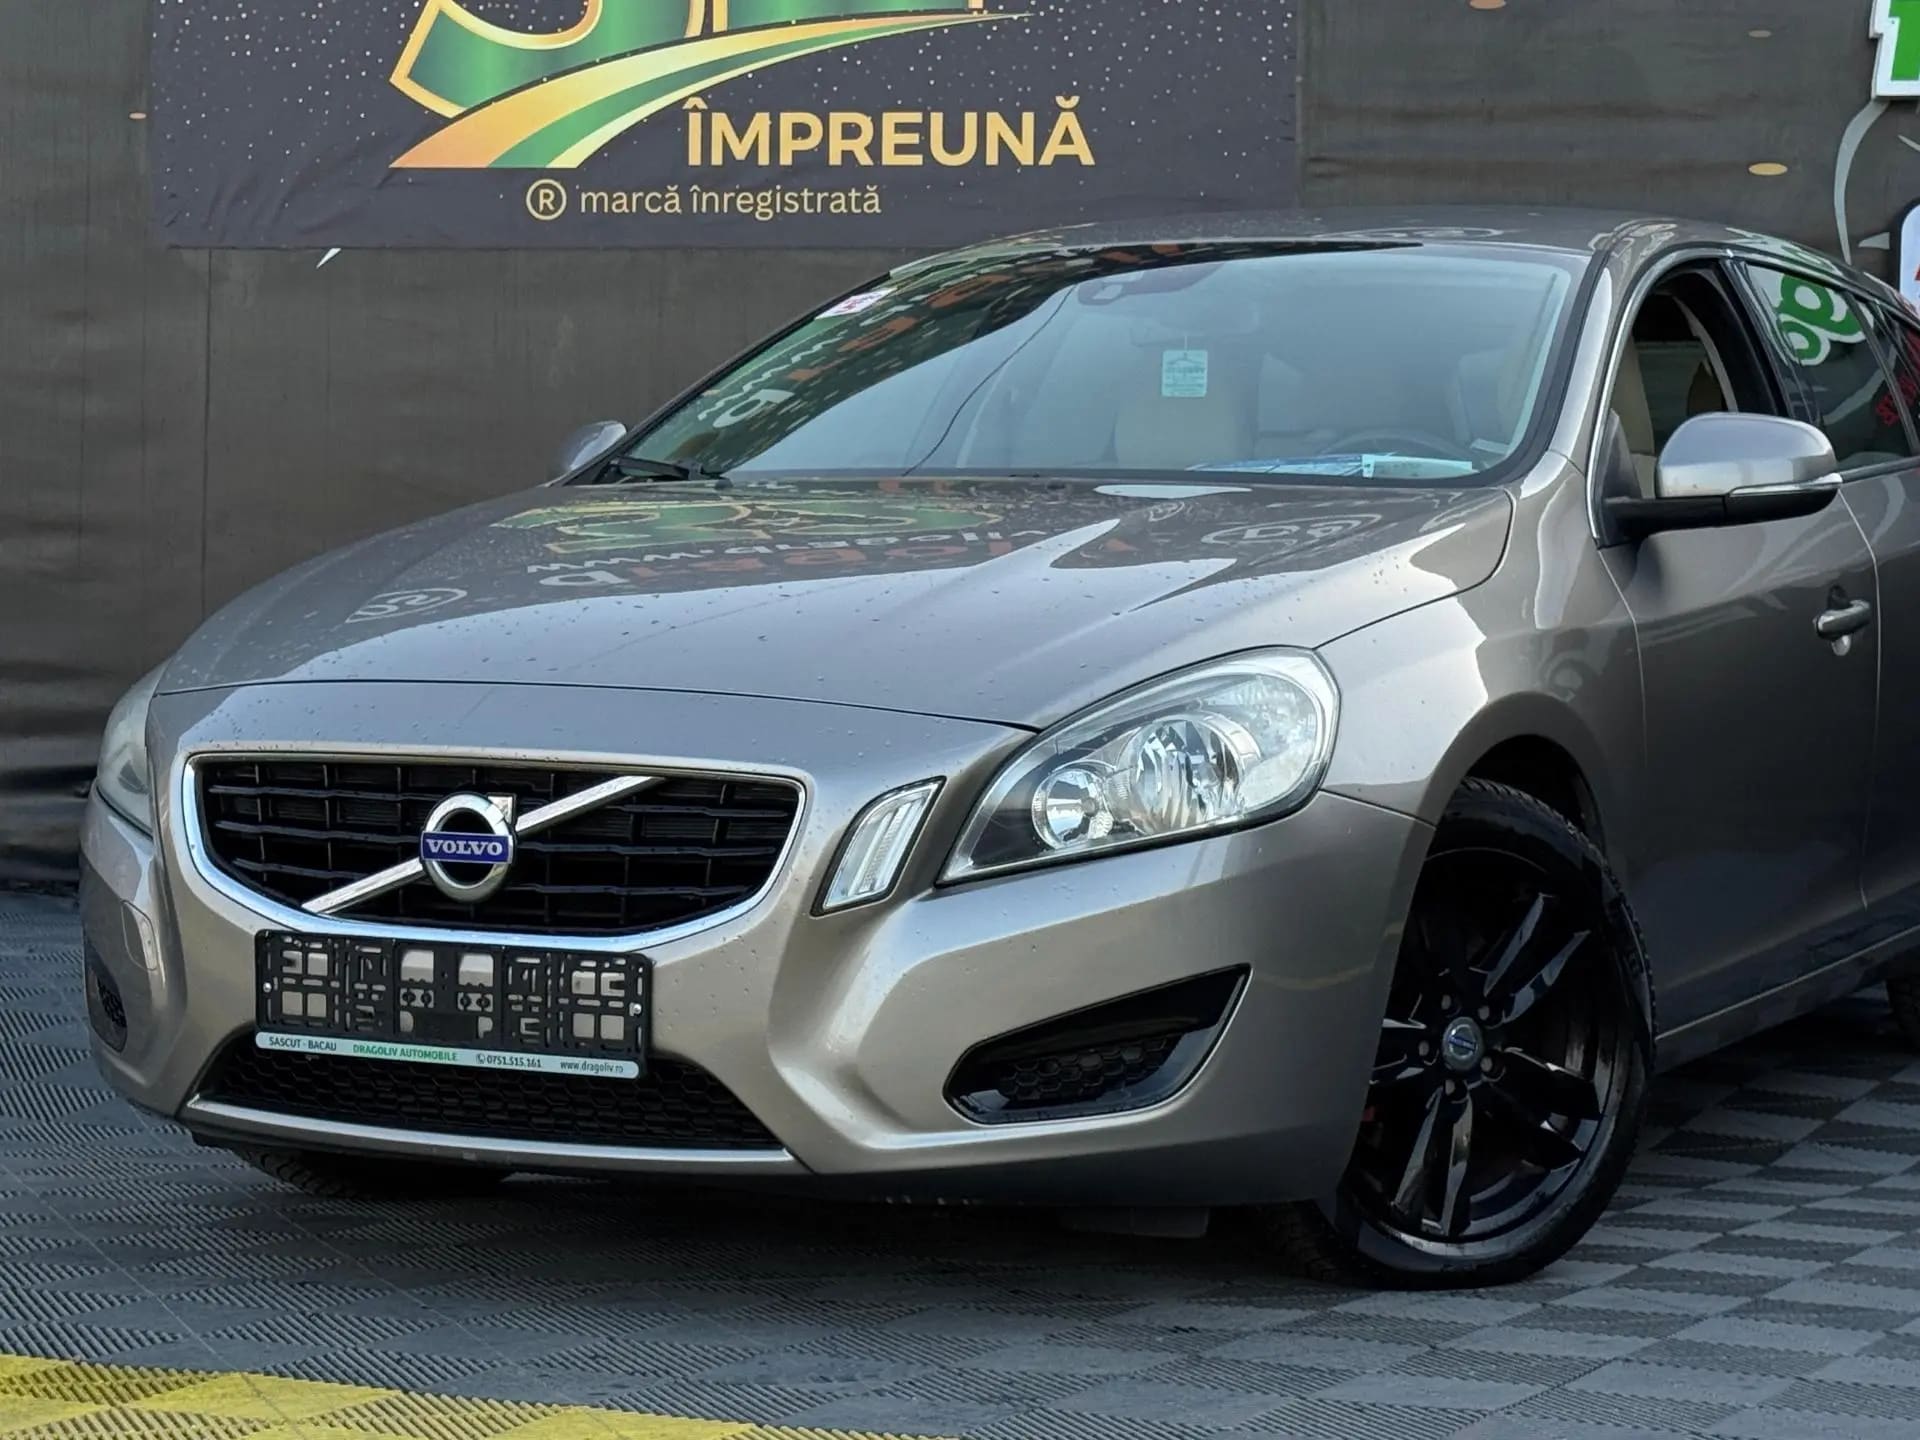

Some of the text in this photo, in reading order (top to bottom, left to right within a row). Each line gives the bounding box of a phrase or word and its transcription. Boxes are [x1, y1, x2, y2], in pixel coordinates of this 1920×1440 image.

[682, 95, 1095, 167] ÎMPREUNĂ
[579, 186, 682, 215] marcă
[690, 183, 882, 222] înregistrată
[426, 838, 503, 856] VOLVO
[269, 1036, 300, 1049] SASCUT
[352, 1043, 398, 1057] DRAGOLIV
[399, 1047, 458, 1062] AUTOMOBILE
[560, 1060, 624, 1075] www.dragoliv.ro
